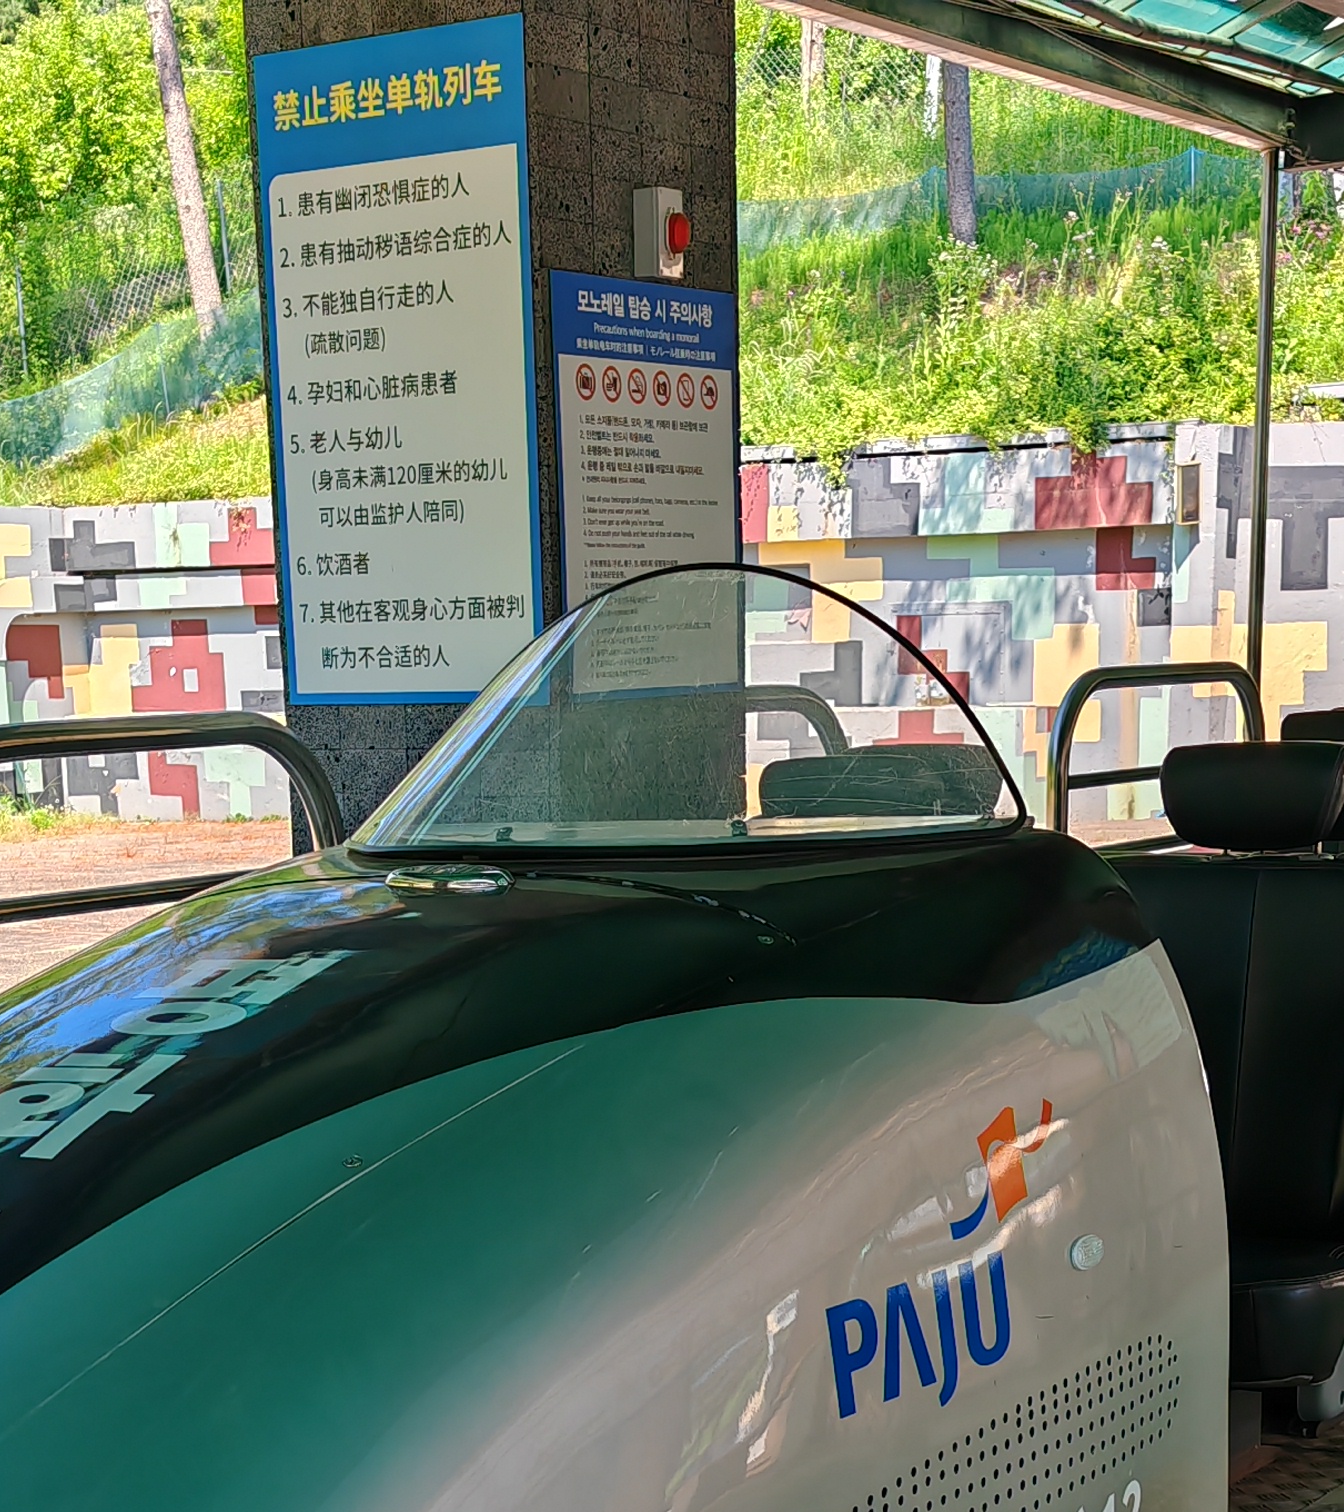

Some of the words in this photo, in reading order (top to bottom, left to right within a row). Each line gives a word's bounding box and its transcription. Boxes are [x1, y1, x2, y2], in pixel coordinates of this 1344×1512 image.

[273, 59, 502, 131] 禁止乘坐单轨列车
[277, 197, 292, 217] 1.
[297, 172, 469, 217] 患有幽闭恐惧症的人
[280, 247, 295, 267] 2.
[300, 220, 512, 267] 患有抽动秽语综合症的人
[283, 298, 297, 318] 3.
[302, 280, 454, 317] 不能独自行走的人
[577, 290, 624, 317] 모노레일
[628, 295, 651, 321] 탑승
[655, 299, 666, 322] 시
[669, 301, 712, 328] 주의사항
[305, 327, 385, 358] (疏散问题)
[287, 386, 302, 405] 4.
[308, 370, 458, 405] 孕妇和心脏病患者
[290, 435, 305, 454] 5.
[310, 426, 403, 454] 老人与幼儿
[312, 459, 507, 493] (身高未满120厘米的幼儿
[319, 499, 464, 527] 可以由监护人陪同)
[297, 557, 311, 575] 6.
[316, 551, 370, 576] 饮酒者
[299, 604, 314, 623] 7.
[320, 595, 525, 623] 其他在客观身心方面被判
[322, 645, 450, 669] 断为不合适的人
[825, 1252, 1010, 1420] PAJU
